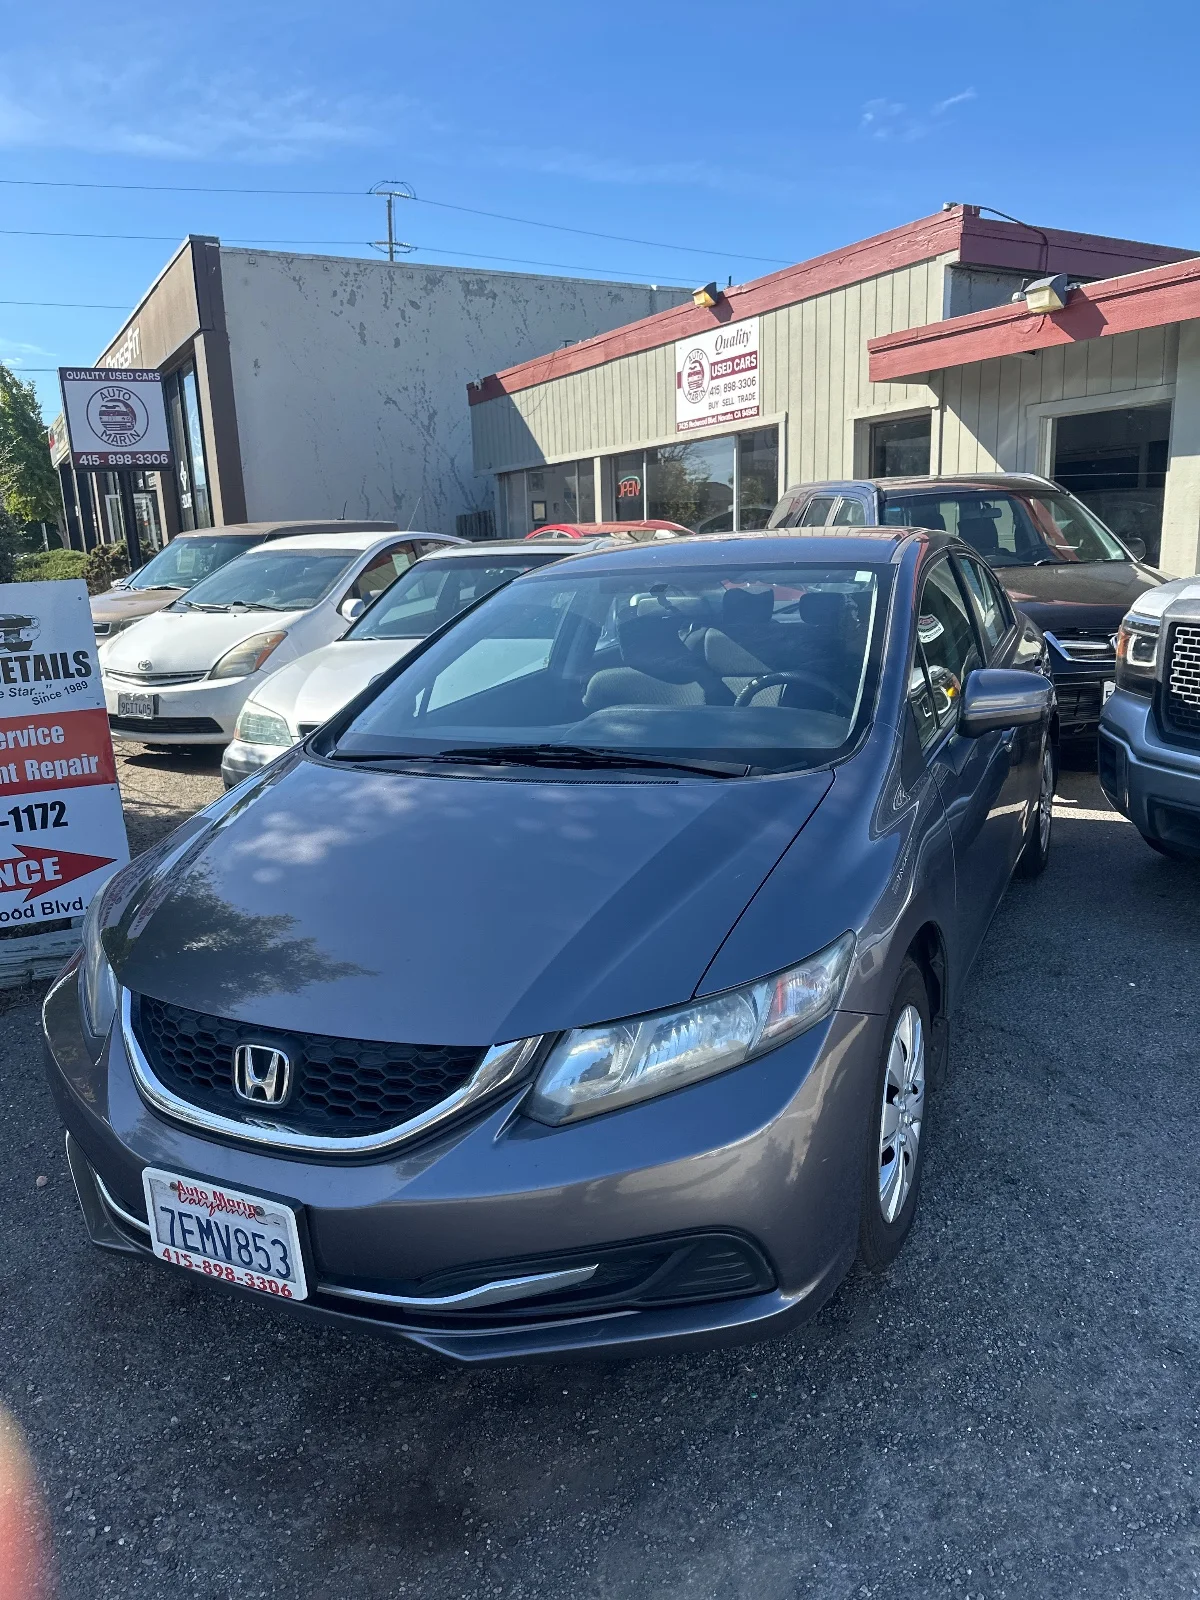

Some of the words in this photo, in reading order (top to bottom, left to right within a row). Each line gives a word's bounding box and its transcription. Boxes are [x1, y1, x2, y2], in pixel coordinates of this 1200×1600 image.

[714, 328, 752, 356] Quality
[688, 350, 704, 363] AUTO
[711, 362, 733, 377] USED
[733, 354, 757, 371] CARS
[66, 371, 106, 380] QUALITY
[108, 372, 134, 380] USED
[135, 372, 161, 381] CARS
[723, 376, 757, 393] 898-3306
[99, 388, 132, 402] AUTO
[708, 401, 719, 410] BUY
[721, 397, 735, 407] SELL
[737, 391, 757, 403] TRADE
[733, 410, 742, 419] CA
[100, 429, 141, 445] MARIN
[78, 454, 105, 465] 415-
[107, 453, 169, 465] 898-3306
[0, 650, 92, 685] ETAILS
[31, 690, 62, 706] Since
[63, 680, 89, 696] 1989
[0, 724, 65, 750] ervice
[24, 753, 99, 781] Repair
[0, 800, 69, 833] -1172
[0, 904, 35, 922] ood
[41, 897, 89, 916] Blvd.
[177, 1180, 209, 1201] Auto
[212, 1190, 256, 1213] Marin
[177, 1190, 268, 1225] California
[160, 1205, 291, 1279] 7EMV853
[162, 1247, 293, 1298] 415-898-3306
